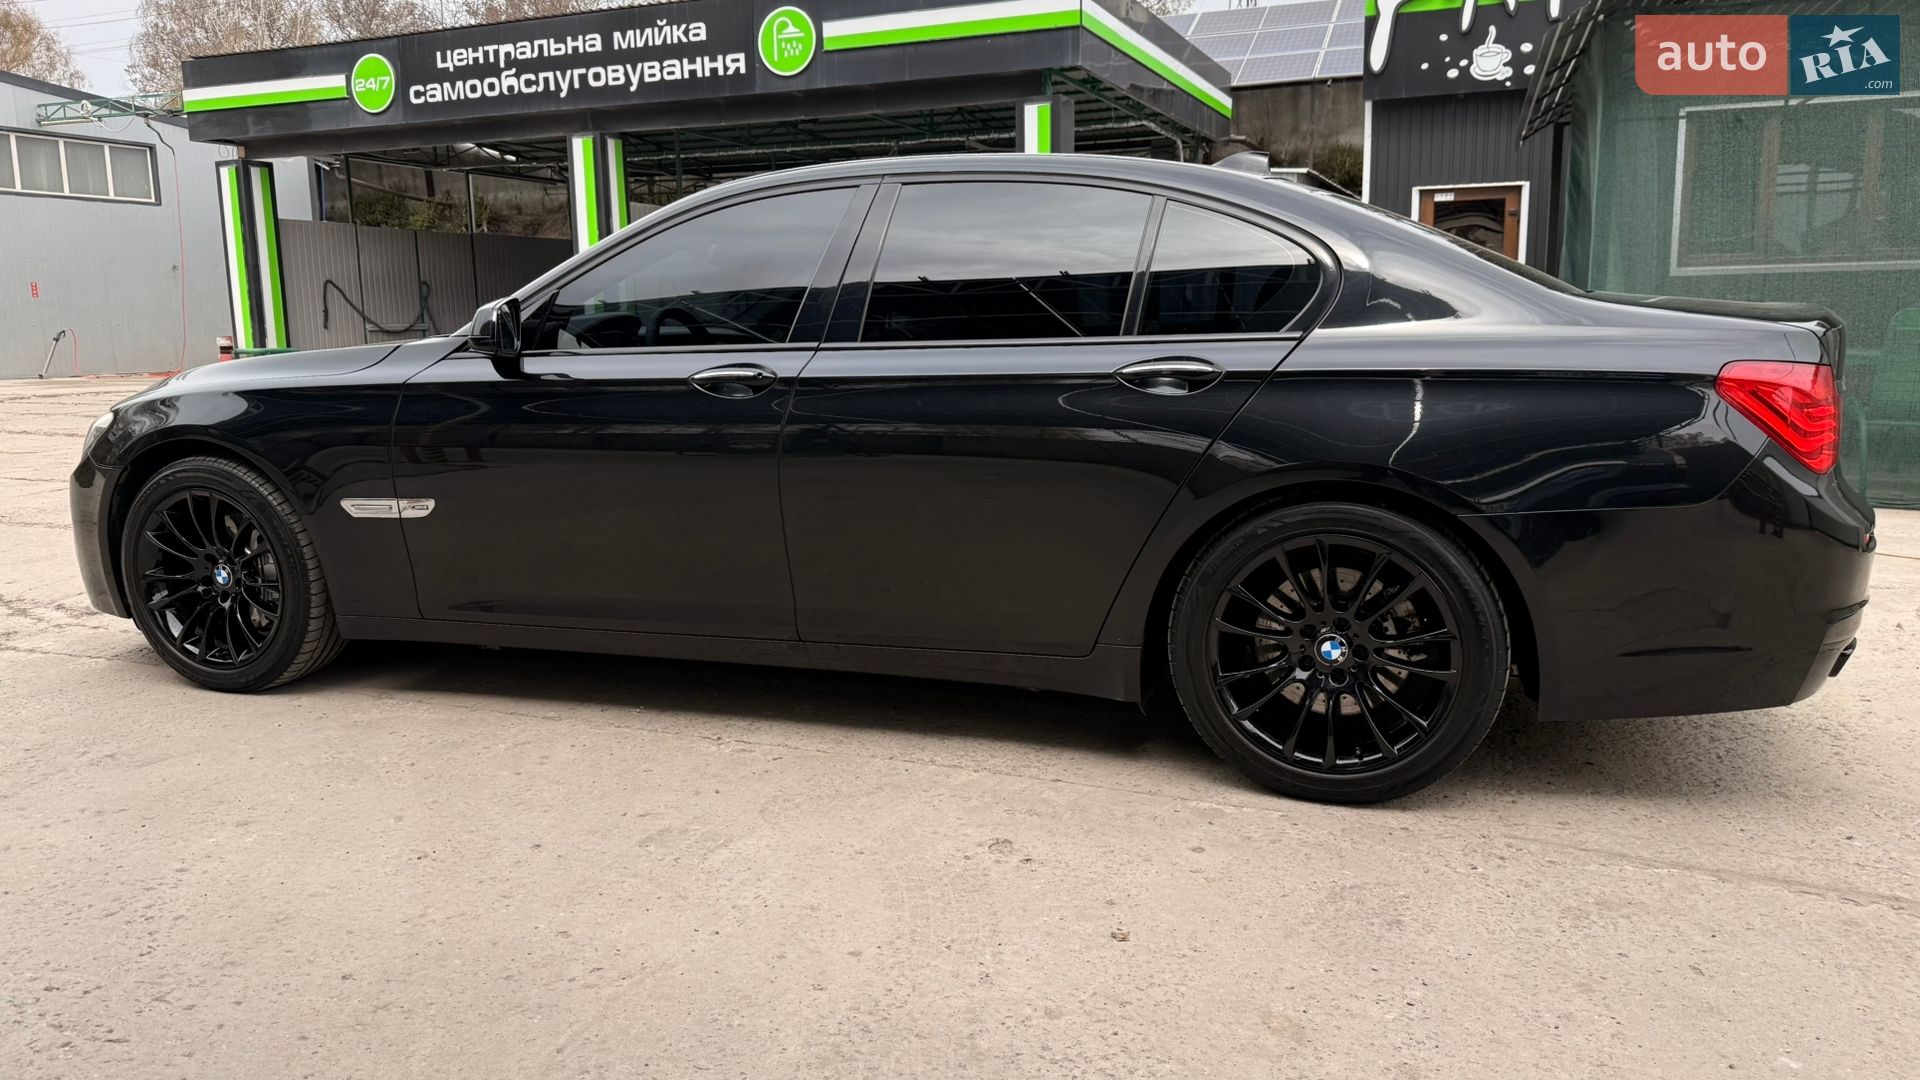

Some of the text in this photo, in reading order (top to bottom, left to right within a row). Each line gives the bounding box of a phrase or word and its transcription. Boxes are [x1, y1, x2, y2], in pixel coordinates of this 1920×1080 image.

[436, 19, 706, 72] центральна мийка
[355, 76, 391, 91] 24/7
[409, 53, 747, 104] самообслуговування
